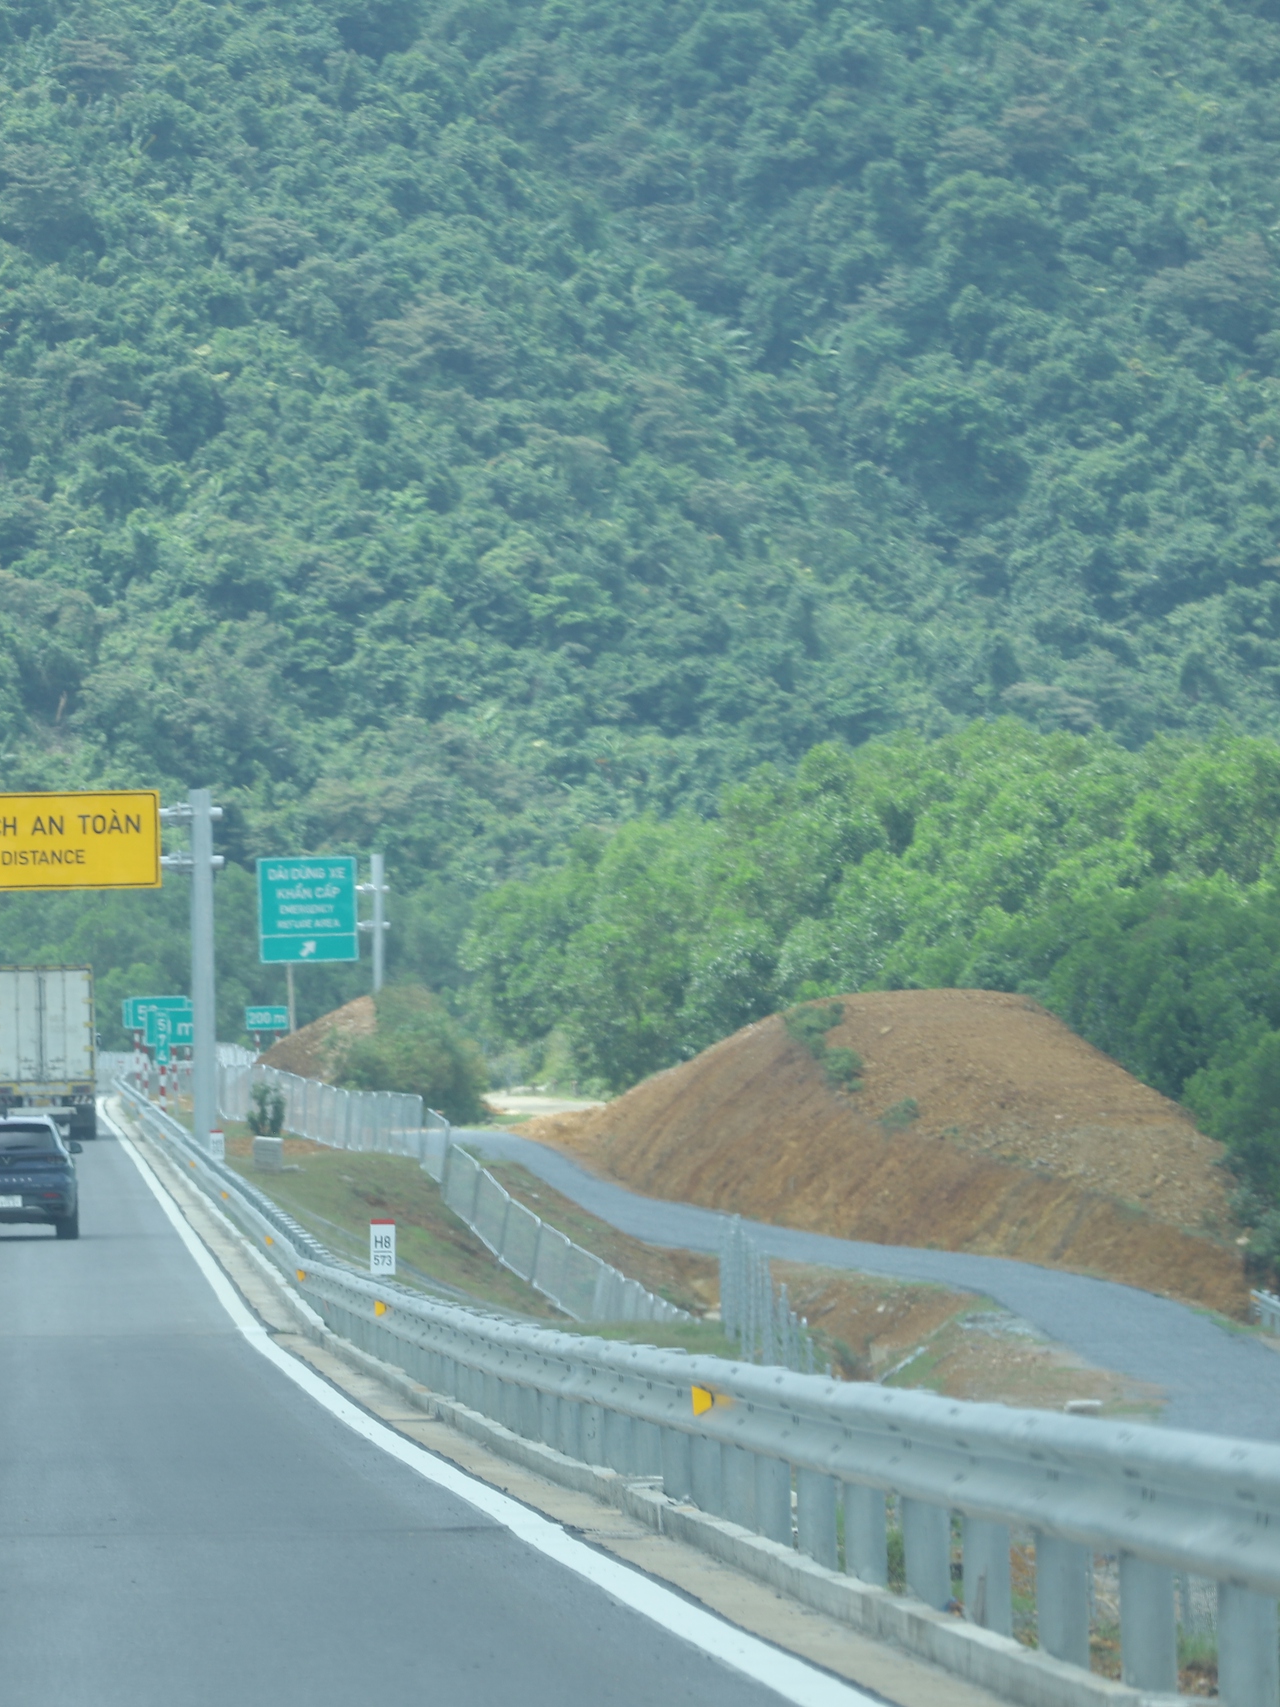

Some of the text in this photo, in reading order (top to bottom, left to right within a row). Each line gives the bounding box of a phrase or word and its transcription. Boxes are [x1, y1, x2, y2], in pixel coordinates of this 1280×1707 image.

[31, 815, 64, 836] AN
[77, 808, 141, 834] TOÀN
[1, 849, 86, 866] DISTANCE
[248, 1011, 286, 1024] 200 m
[374, 1235, 391, 1249] H8
[373, 1254, 392, 1266] 573
